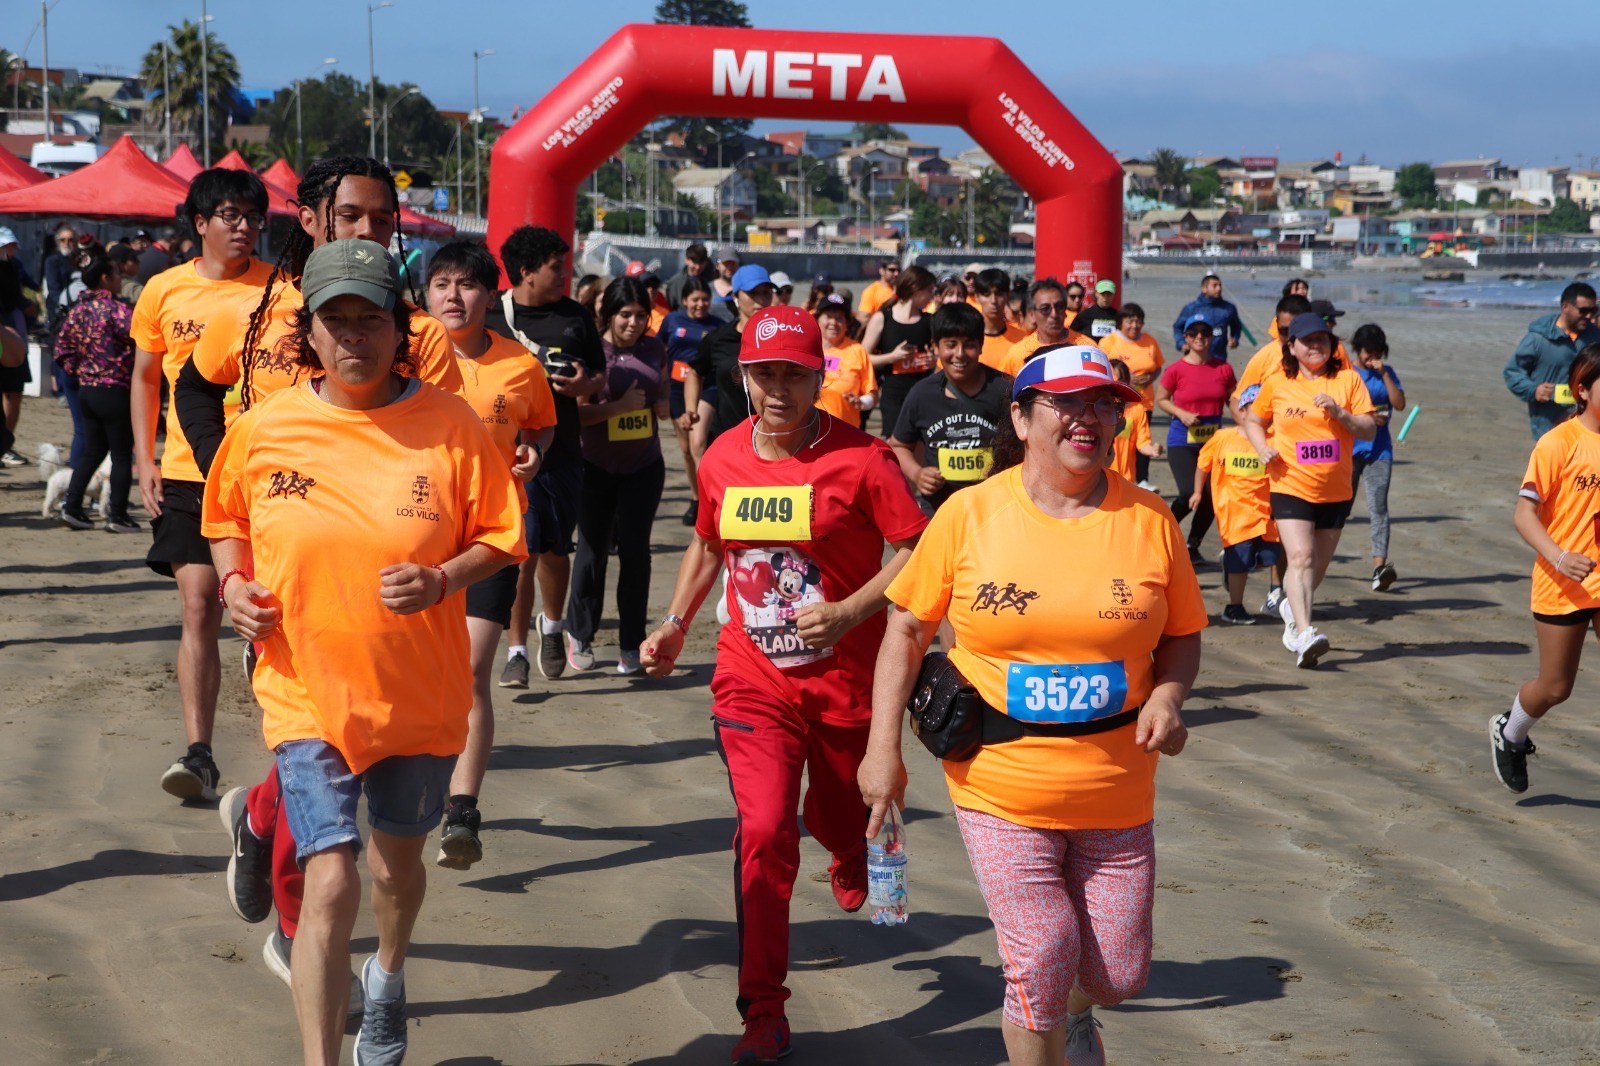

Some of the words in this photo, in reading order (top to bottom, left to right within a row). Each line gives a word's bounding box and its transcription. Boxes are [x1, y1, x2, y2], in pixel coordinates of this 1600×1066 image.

[713, 49, 907, 103] META
[541, 129, 564, 151] LOS
[561, 104, 592, 132] VILOS
[591, 76, 624, 108] JUNTO
[561, 133, 577, 148] AL
[574, 94, 620, 136] DEPORTE
[998, 91, 1020, 114] LOS
[1017, 110, 1046, 141] VILOS
[1042, 139, 1075, 171] JUNTO
[1001, 112, 1016, 127] AL
[1014, 123, 1058, 168] DEPORTE
[617, 414, 648, 431] 4054
[926, 420, 944, 438] STAY
[945, 413, 963, 425] OUT
[948, 454, 985, 470] 4056
[1232, 457, 1259, 469] 4025
[1301, 444, 1333, 460] 3819
[396, 507, 414, 518] LOS
[416, 510, 440, 522] VILOS
[735, 497, 793, 523] 4049
[1098, 610, 1121, 620] LOS
[1122, 611, 1148, 620] VILOS
[750, 634, 815, 653] GLADY
[1011, 666, 1021, 674] 5K
[1025, 675, 1110, 712] 3523
